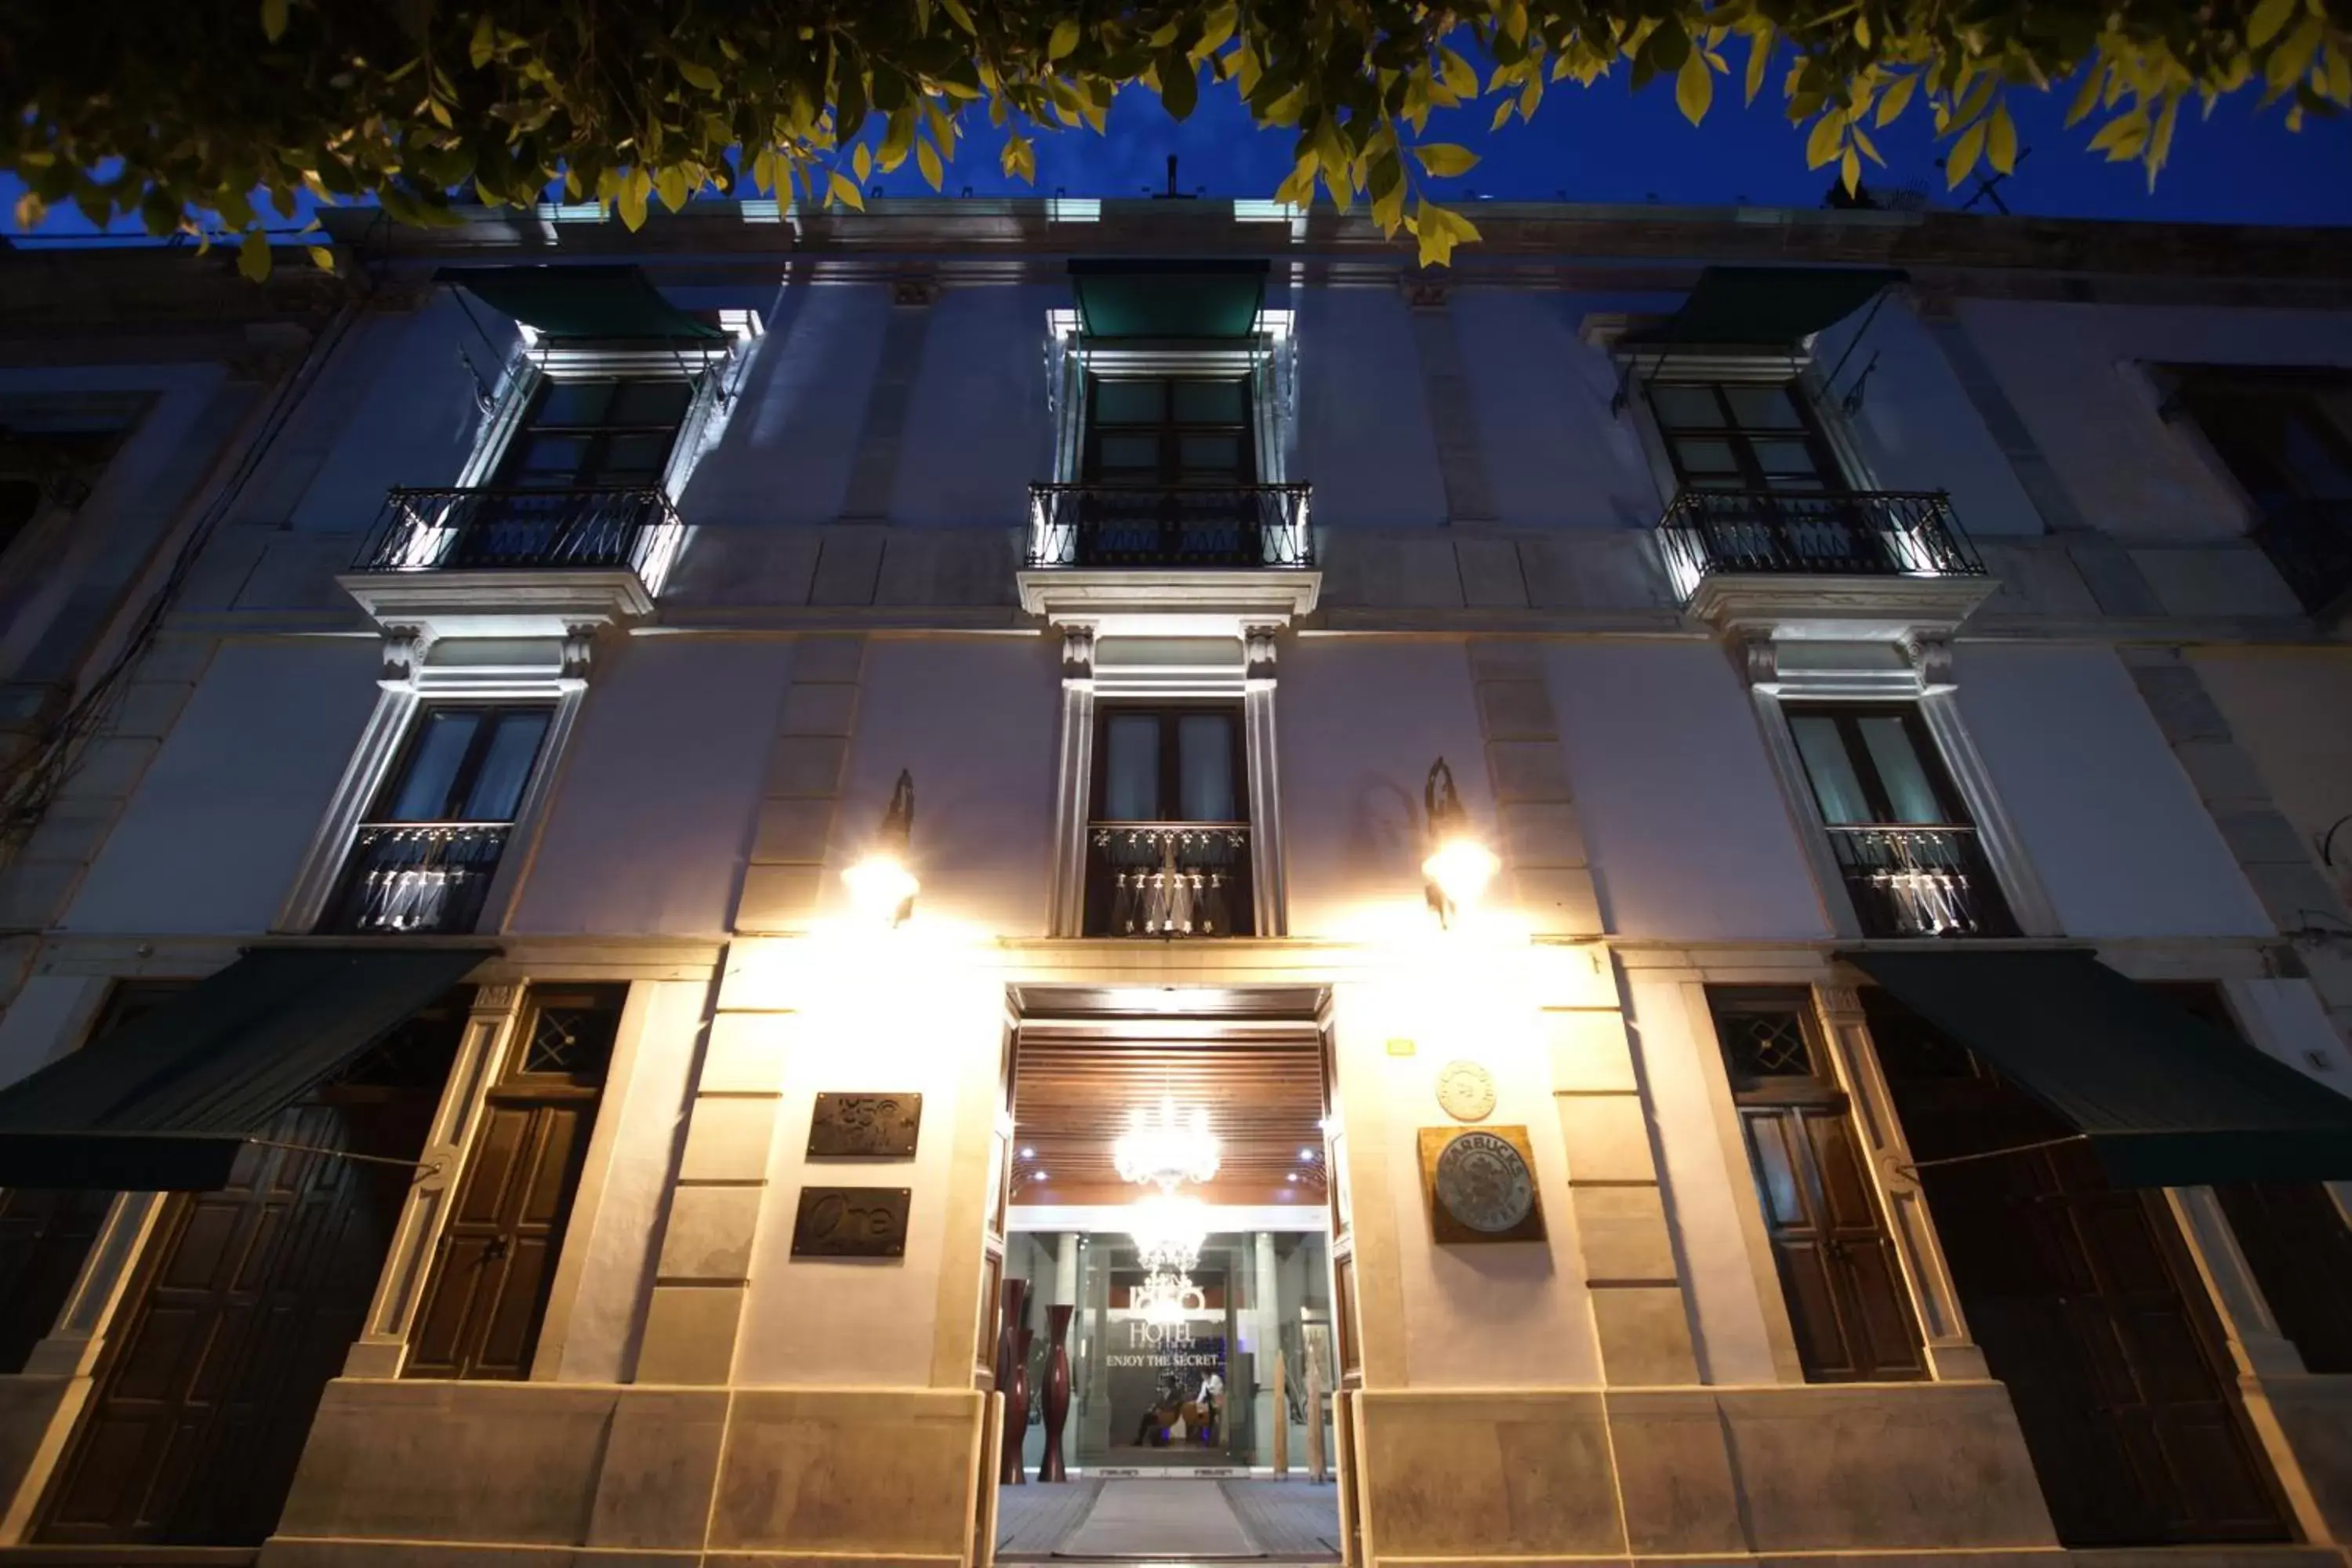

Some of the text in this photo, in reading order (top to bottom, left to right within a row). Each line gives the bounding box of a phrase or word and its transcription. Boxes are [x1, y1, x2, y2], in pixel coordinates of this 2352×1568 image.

[1130, 1323, 1194, 1342] HOTEL
[1106, 1354, 1145, 1367] ENJOY
[1146, 1354, 1171, 1367] THE
